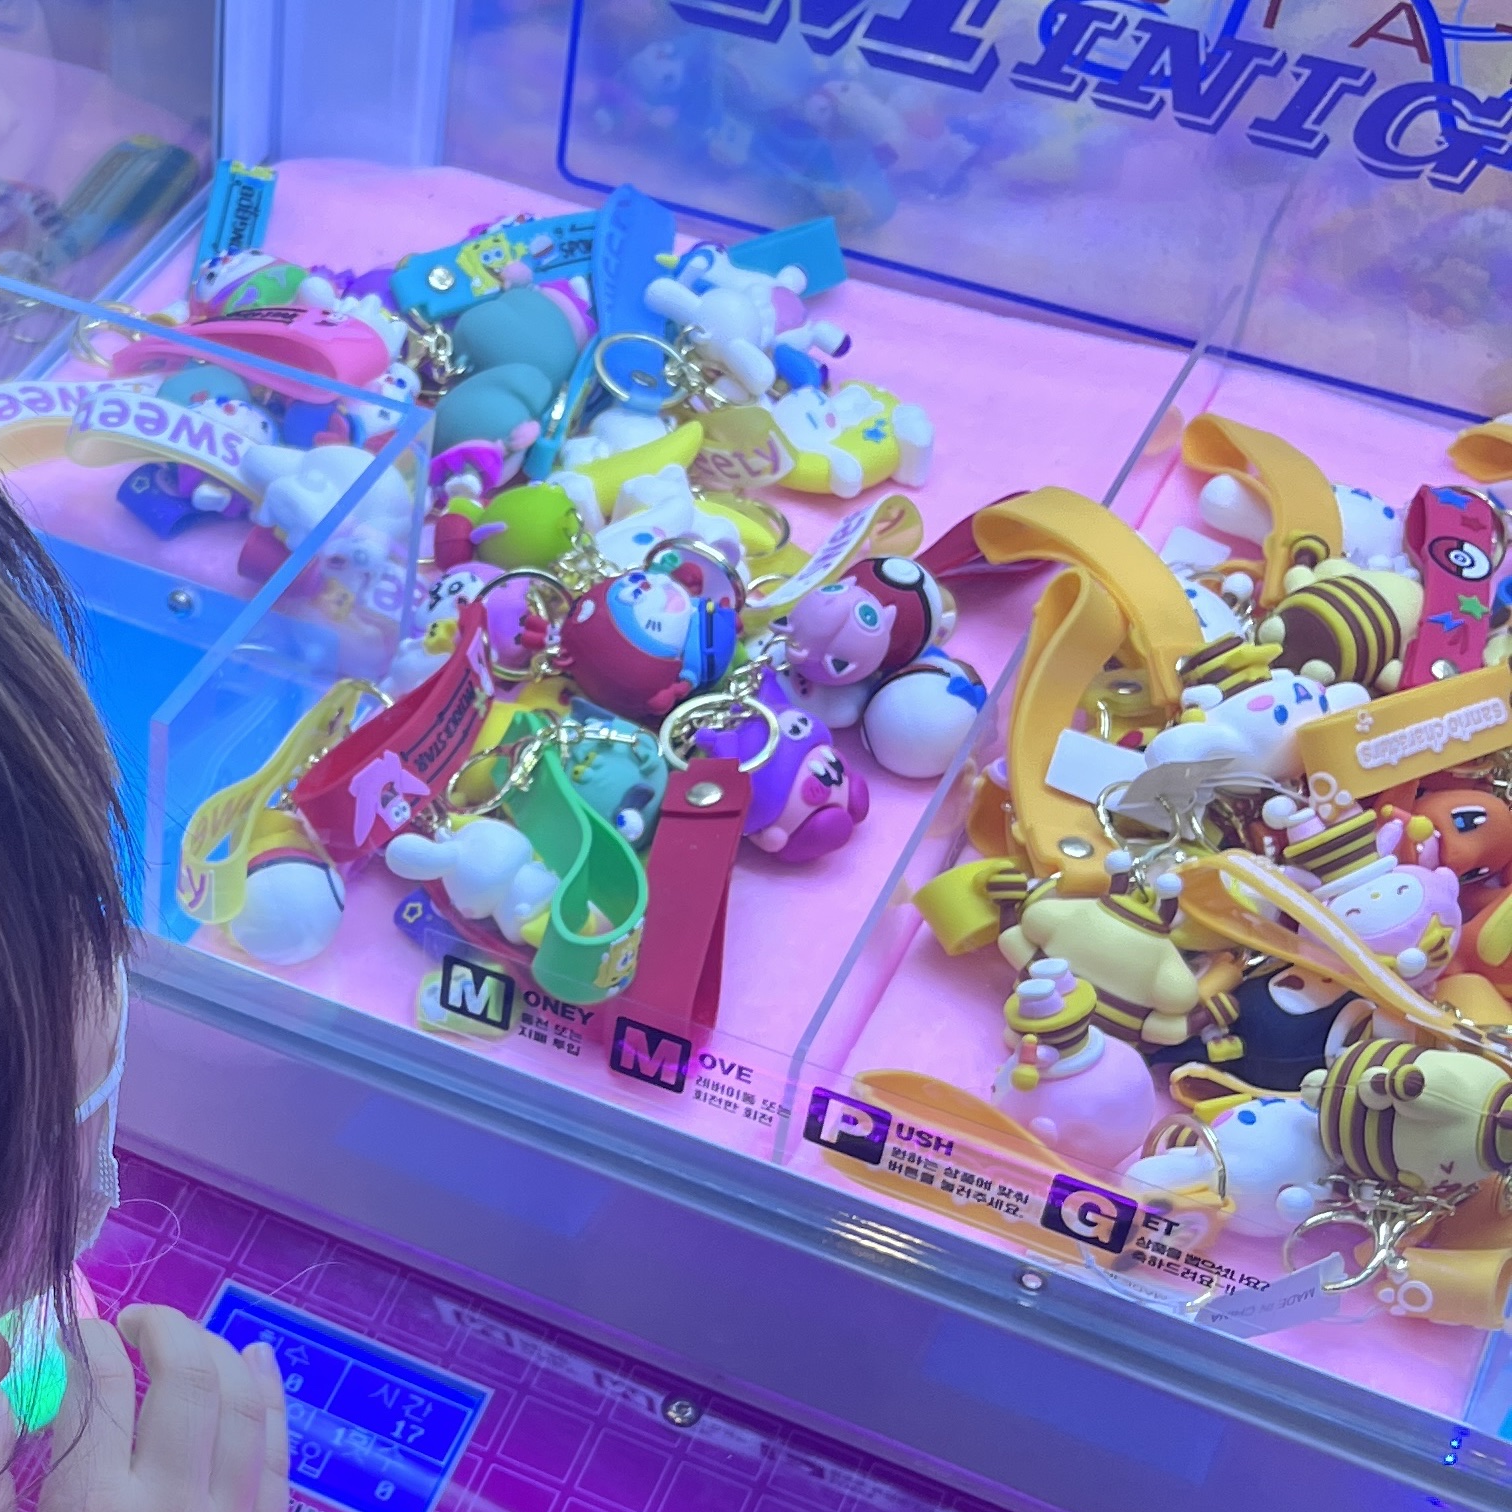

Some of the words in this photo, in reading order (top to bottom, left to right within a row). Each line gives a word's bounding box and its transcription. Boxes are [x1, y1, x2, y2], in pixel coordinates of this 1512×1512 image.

[368, 1383, 433, 1424] 시간
[390, 1420, 426, 1444] 17
[374, 1479, 396, 1502] 0
